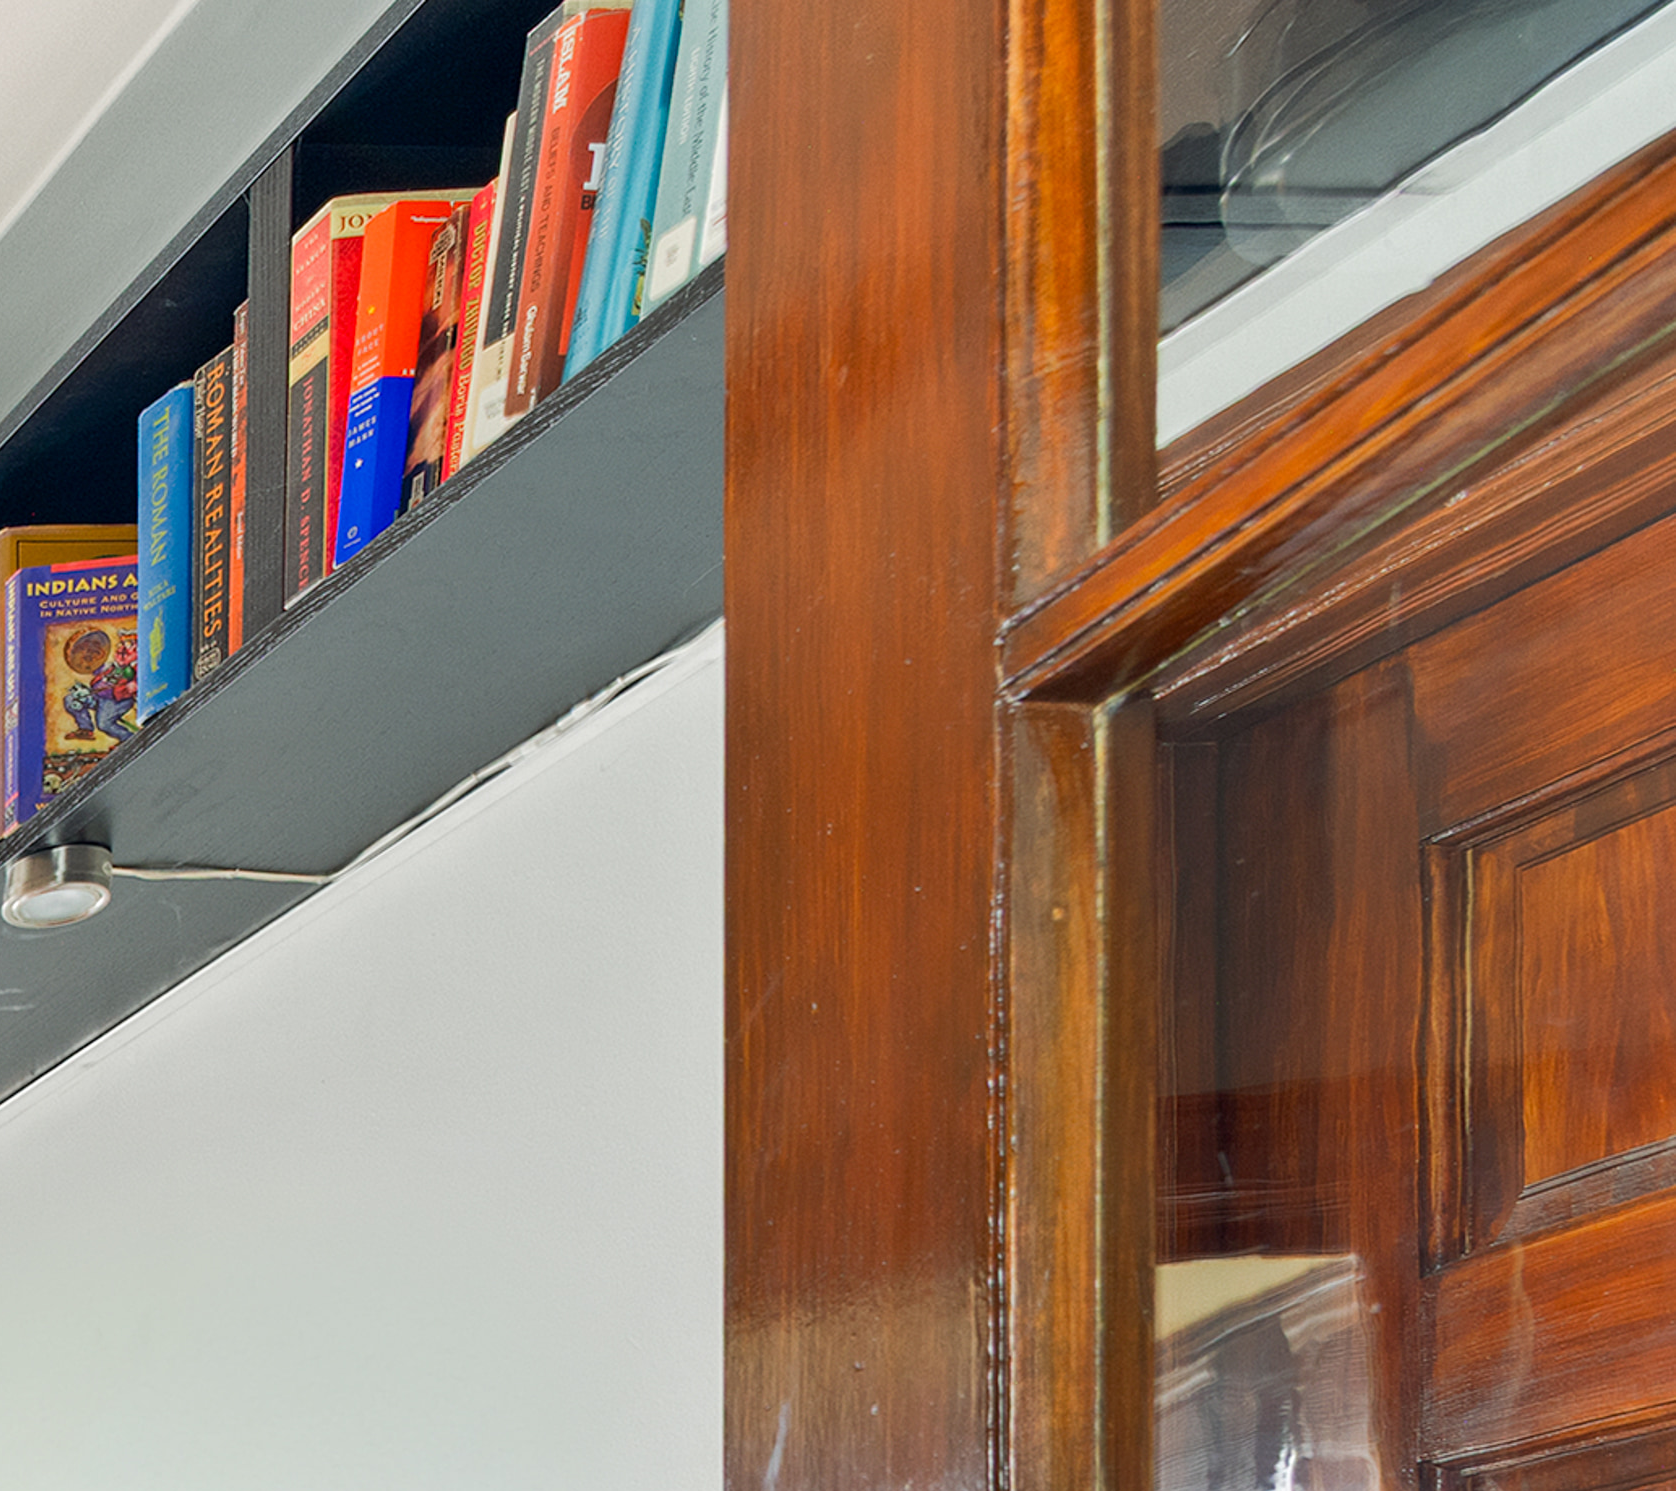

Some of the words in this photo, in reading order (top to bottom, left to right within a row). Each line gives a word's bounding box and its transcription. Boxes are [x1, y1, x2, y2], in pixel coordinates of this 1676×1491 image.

[552, 26, 578, 114] ISLAM
[544, 125, 562, 182] BELIEFS
[540, 184, 555, 213] AND
[468, 222, 489, 291] DOCTOR
[530, 214, 552, 294] TEACHINGS
[294, 299, 328, 334] CHINA
[356, 323, 385, 347] ABOUT
[458, 292, 481, 372] ZHIVAGO
[522, 303, 539, 354] Ghulam
[357, 336, 381, 358] FACE
[515, 353, 532, 396] Sarwar
[152, 405, 172, 466] THE
[203, 359, 227, 478] ROMAN
[301, 375, 313, 485] JONATHAN
[348, 416, 378, 438] JAMES
[348, 428, 375, 449] MANN
[149, 468, 169, 568] ROMAN
[300, 487, 312, 512] D.
[203, 480, 226, 640] REALITIES
[26, 573, 119, 597] INDIANS
[39, 597, 97, 609] CULTURE
[99, 594, 127, 605] AND
[7, 580, 17, 643] INDIANS
[40, 609, 51, 618] IN
[54, 606, 98, 618] NATIVE
[100, 603, 138, 615] NORTH
[7, 644, 18, 671] ARE
[7, 672, 19, 702] US?
